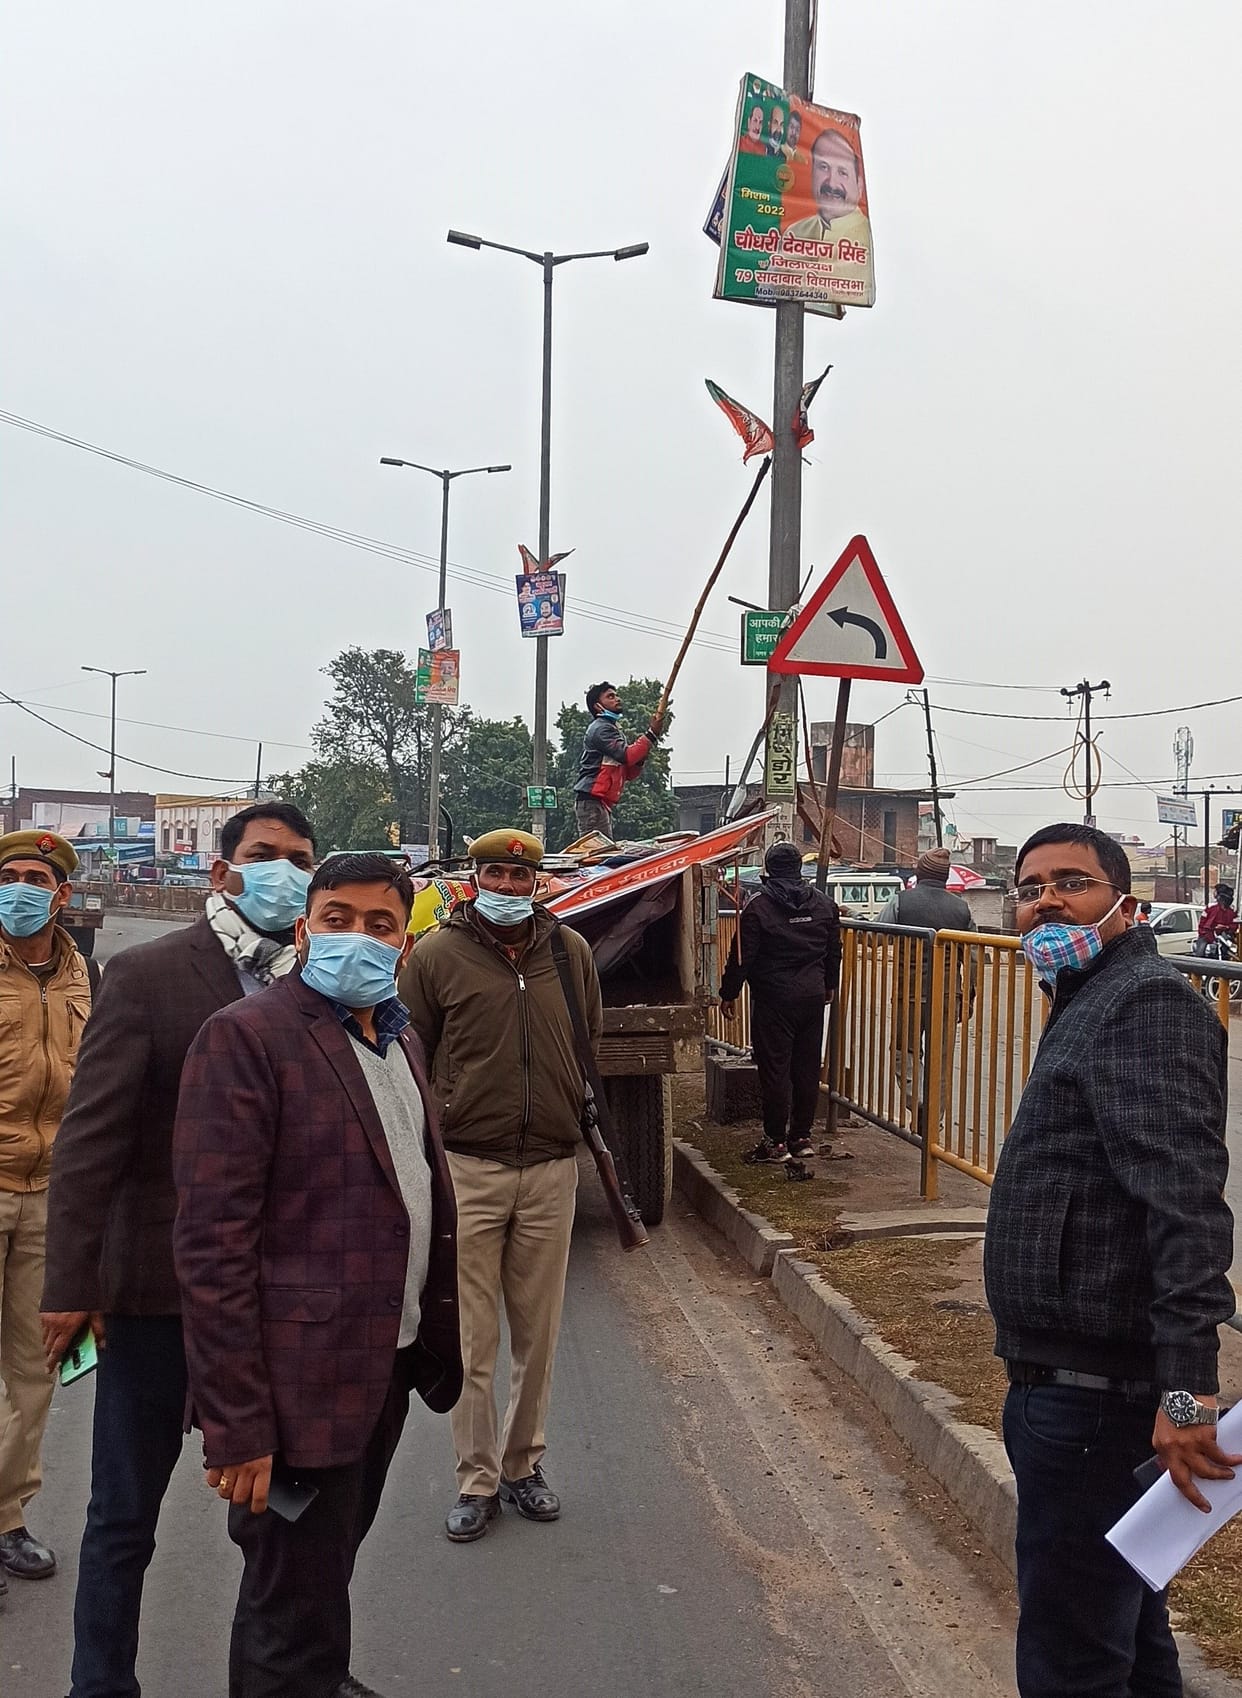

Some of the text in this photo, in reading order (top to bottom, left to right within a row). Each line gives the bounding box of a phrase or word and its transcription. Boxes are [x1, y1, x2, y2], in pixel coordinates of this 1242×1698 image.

[741, 187, 770, 201] मिशन
[757, 203, 785, 216] 2022
[735, 227, 867, 263] चौधरी देवराज सिंह
[736, 270, 864, 290] 79 सादाबाद विधानसभा
[749, 616, 780, 628] आपकी
[755, 633, 779, 644] हमार
